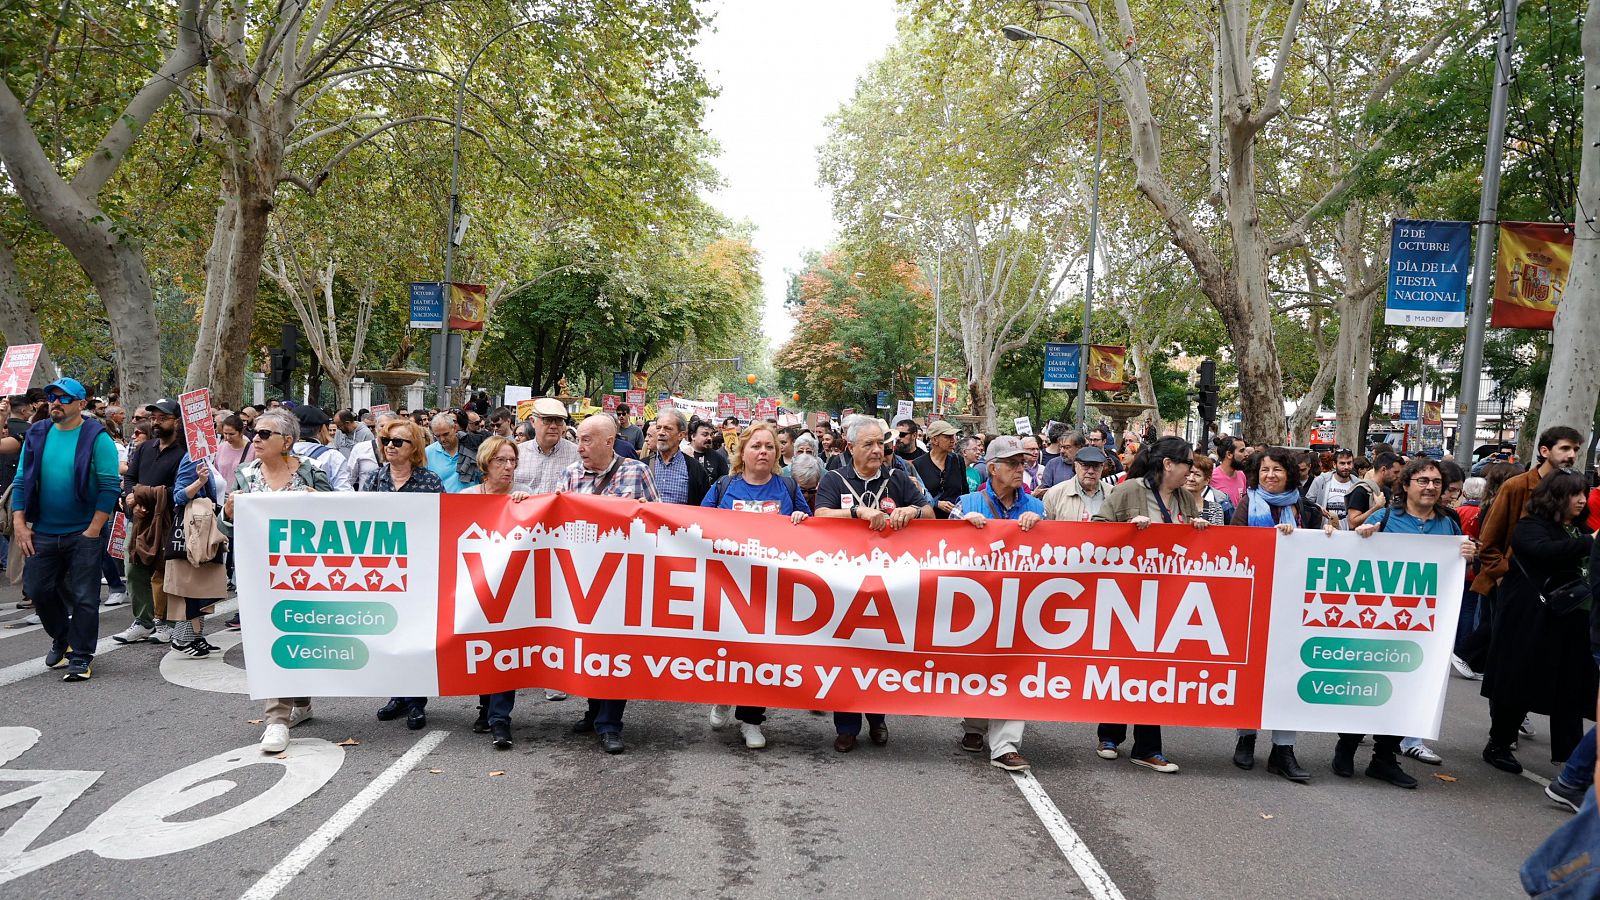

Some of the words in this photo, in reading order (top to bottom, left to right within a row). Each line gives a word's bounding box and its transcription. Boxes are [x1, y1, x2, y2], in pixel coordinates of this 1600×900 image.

[1400, 228, 1408, 238] 12
[1410, 230, 1426, 238] DE
[1398, 241, 1450, 252] OCTUBRE
[1396, 260, 1418, 272] DÍA
[1421, 262, 1438, 272] DE
[1441, 264, 1458, 272] LA
[1396, 276, 1437, 287] FIESTA
[1394, 290, 1460, 302] NACIONAL
[1414, 315, 1444, 323] MADRID
[269, 520, 408, 555] FRAVM
[1306, 558, 1438, 596] FRAVM
[462, 548, 905, 645] VIVIENDA
[932, 576, 1229, 655] DIGNA
[284, 609, 384, 625] Federación
[286, 644, 354, 660] Vecinal
[1312, 646, 1410, 663] Federación
[466, 640, 564, 674] Para
[574, 638, 632, 678] las
[643, 648, 802, 688] vecinas
[815, 666, 842, 698] y
[852, 660, 1008, 697] vecinos
[1020, 662, 1072, 700] de
[1083, 664, 1236, 706] Madrid
[1312, 680, 1378, 696] Vecinal
